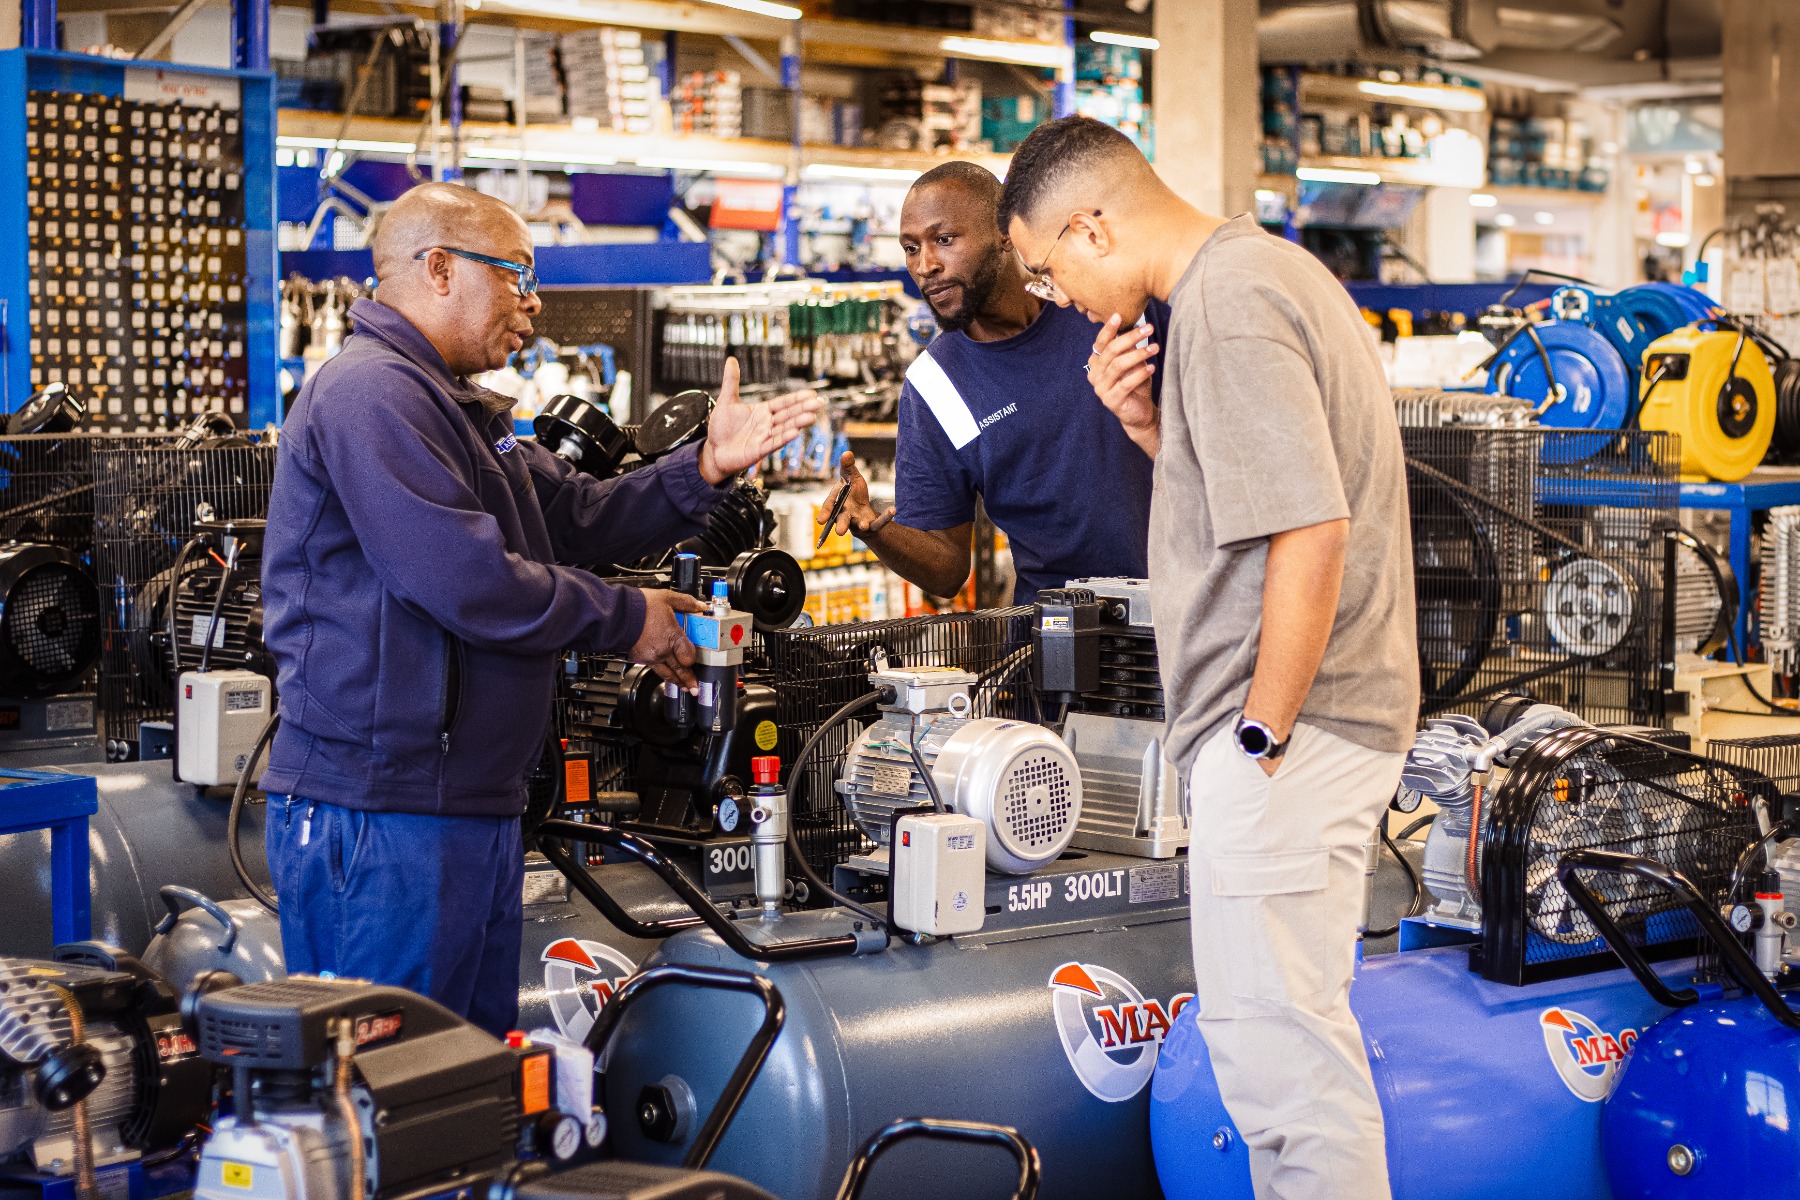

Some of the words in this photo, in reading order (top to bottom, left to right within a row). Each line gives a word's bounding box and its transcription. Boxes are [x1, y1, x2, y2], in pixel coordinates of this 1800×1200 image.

[978, 402, 1018, 431] ASSISTANT
[1008, 882, 1052, 912] 5.5HP
[1064, 870, 1125, 902] 300LT
[158, 1034, 196, 1057] 3.0H
